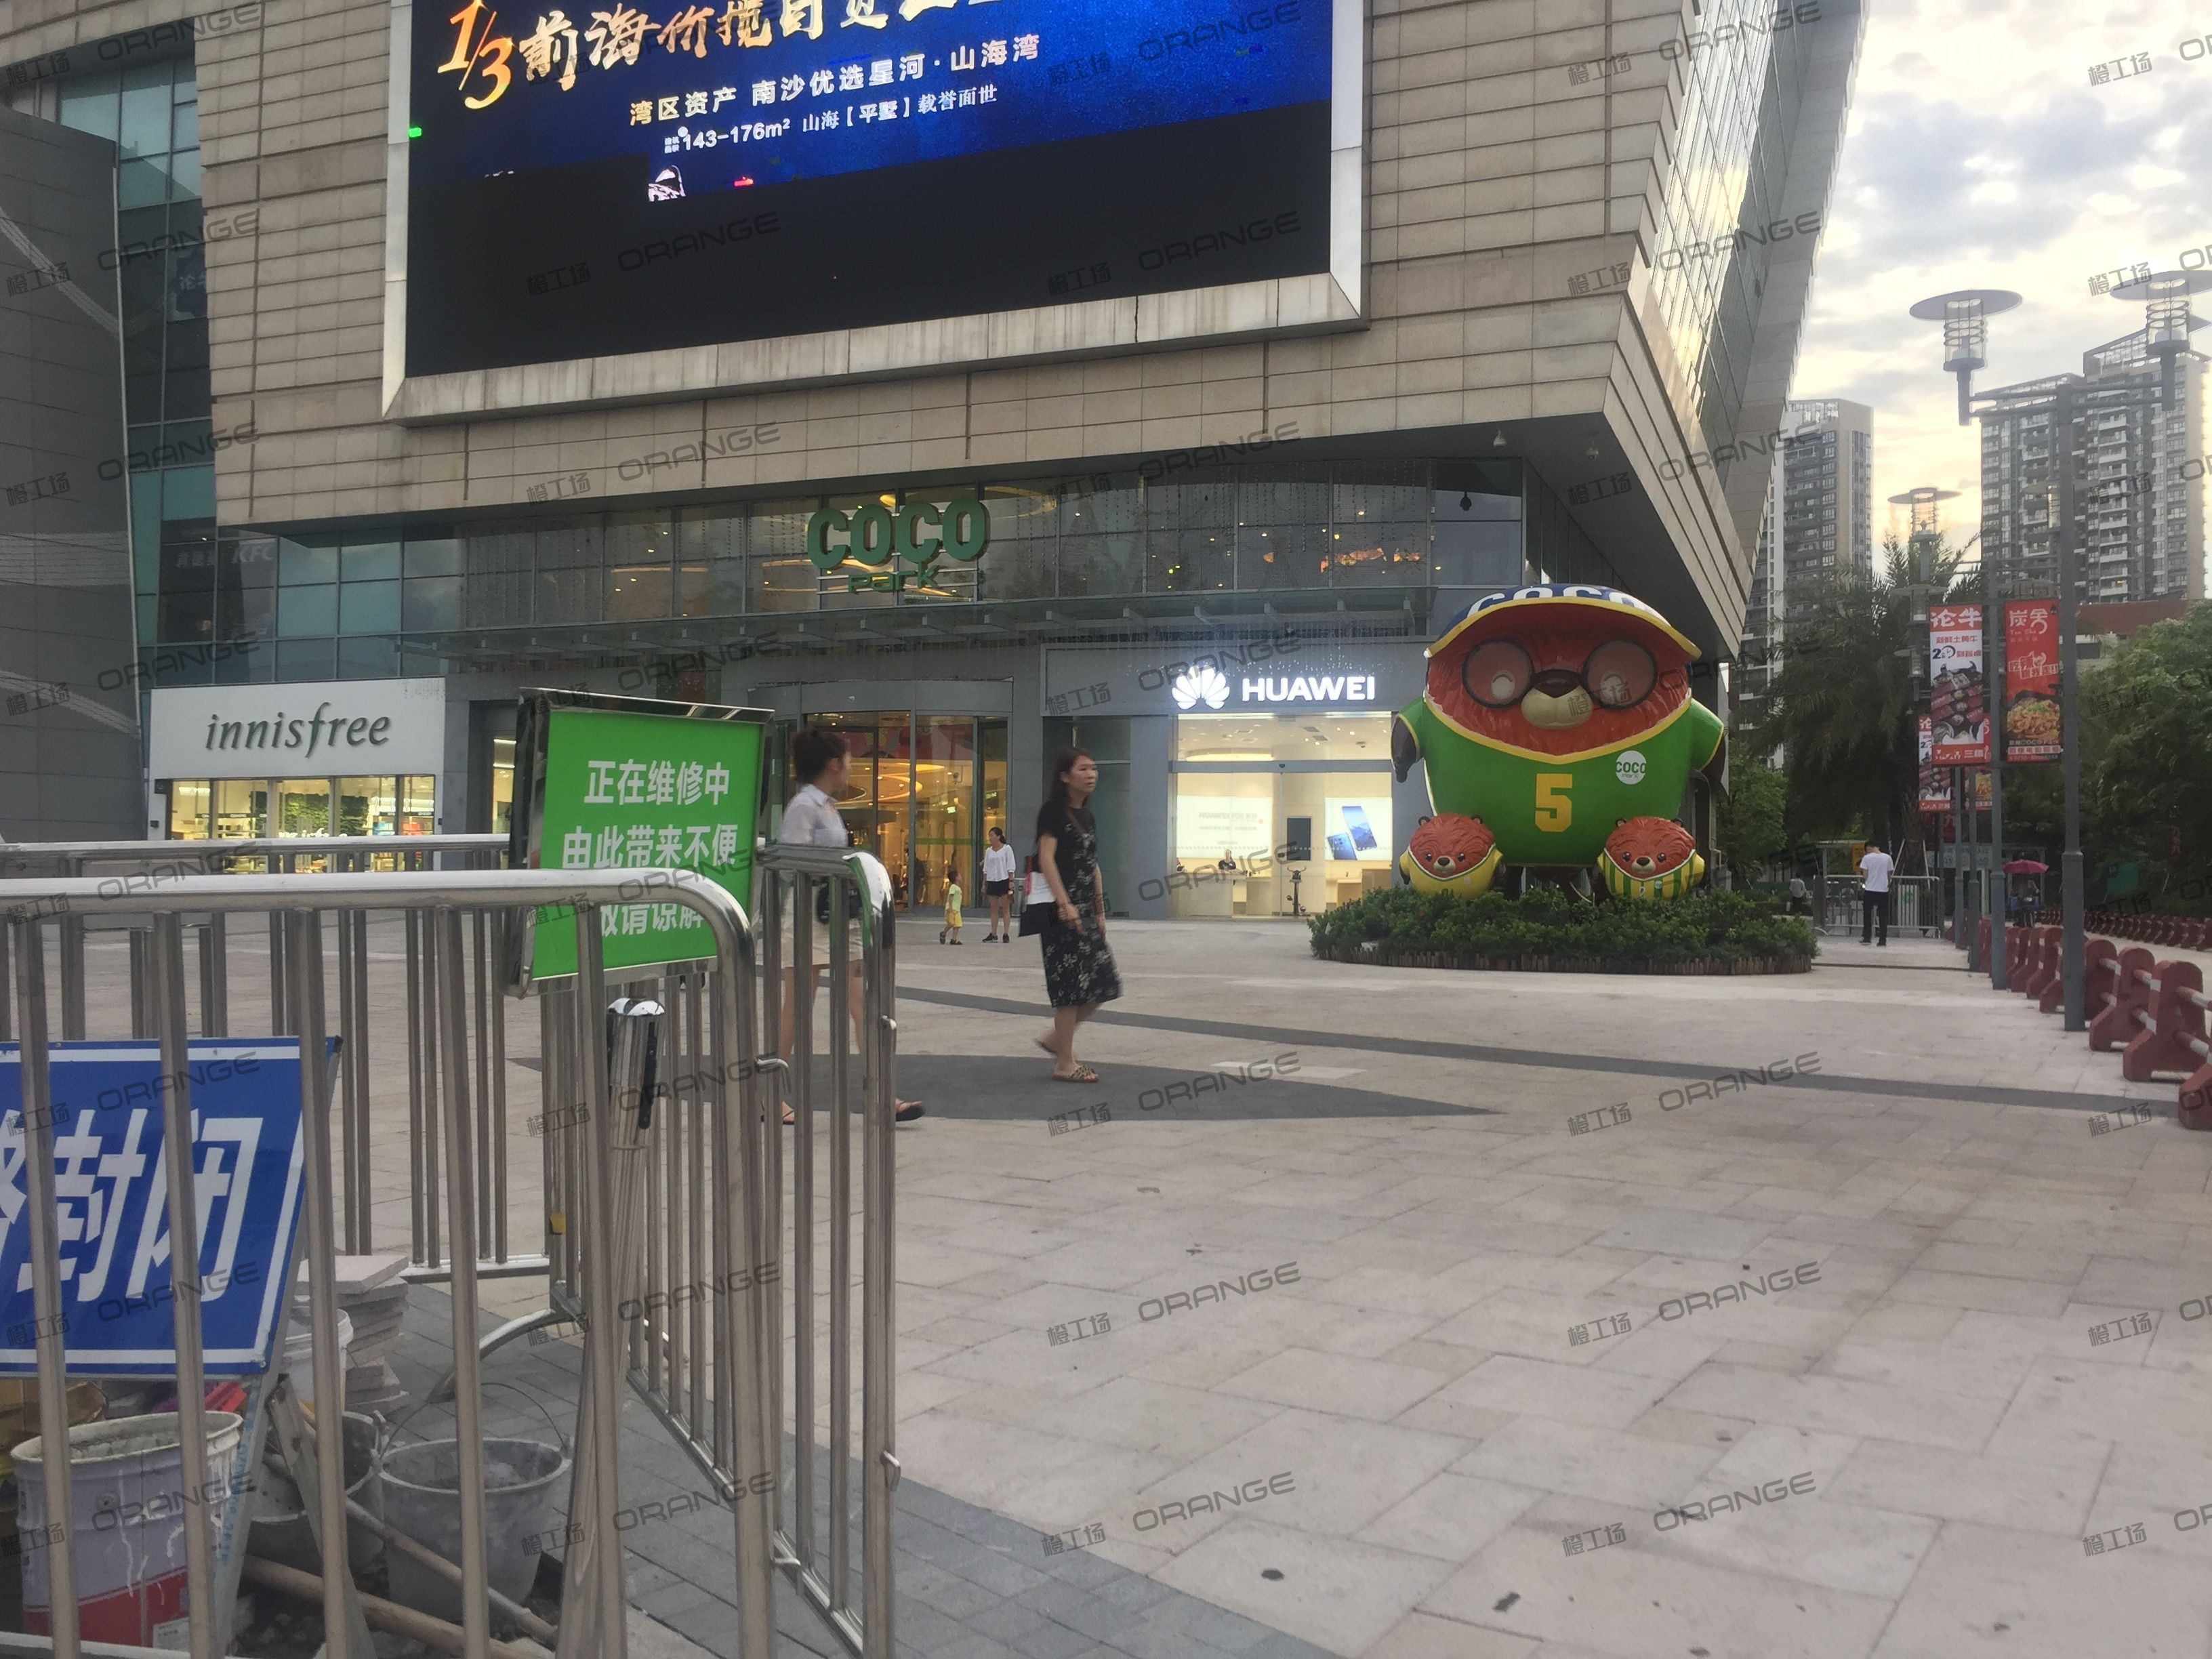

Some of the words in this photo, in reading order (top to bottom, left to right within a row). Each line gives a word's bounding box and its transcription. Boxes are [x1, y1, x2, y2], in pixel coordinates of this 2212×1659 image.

[630, 87, 737, 126] 湾区资产
[807, 497, 989, 569] COCO
[1930, 607, 1983, 628] 论牛
[1242, 676, 1375, 701] HUAWEI
[205, 702, 392, 758] innisfree
[583, 759, 731, 805] 正在维修中
[1616, 762, 1647, 774] COCO
[1535, 773, 1573, 832] 5
[562, 823, 739, 869] 由此带来不便
